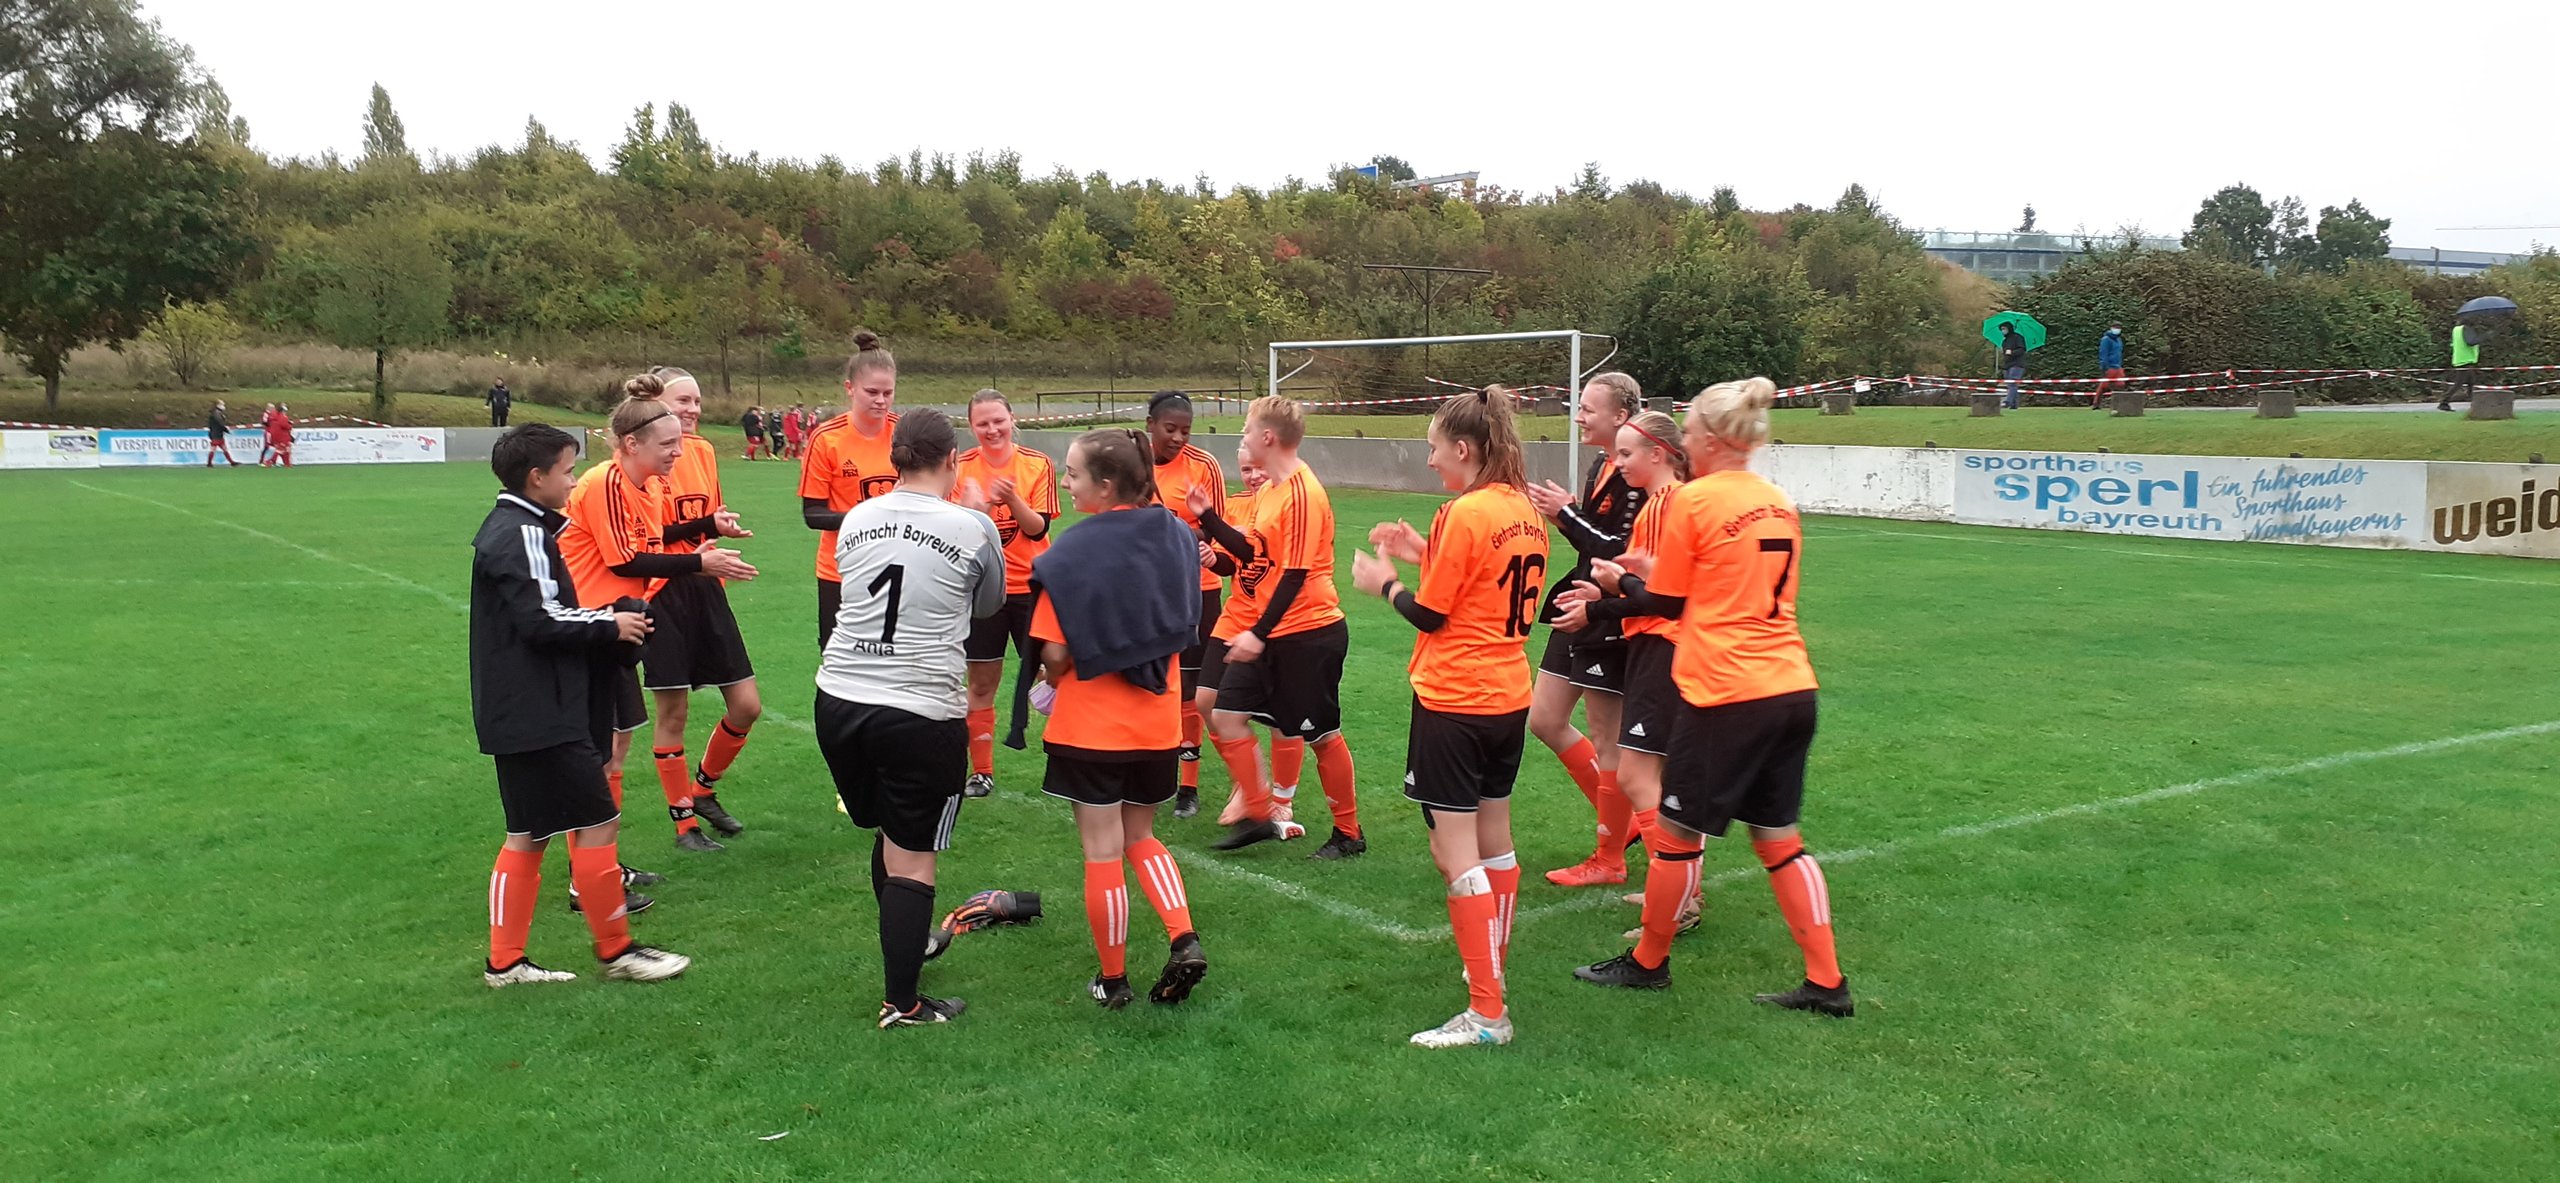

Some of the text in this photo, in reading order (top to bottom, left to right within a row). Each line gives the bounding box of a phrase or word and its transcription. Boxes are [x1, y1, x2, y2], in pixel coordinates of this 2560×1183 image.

[114, 439, 162, 451] VERSPIEL
[166, 438, 198, 450] NICHT
[1964, 455, 2144, 475] sporthaus
[1994, 470, 2200, 510] sperl
[2207, 475, 2243, 498] Ein
[2057, 506, 2222, 532] bayreuth
[2232, 491, 2347, 521] Sporthaus
[2245, 512, 2408, 541] Nordbayerns
[844, 522, 898, 550] Eintracht
[902, 524, 961, 565] Bayreuth
[1757, 538, 1793, 619] 7
[867, 563, 904, 644] 1
[1497, 553, 1545, 637] 16
